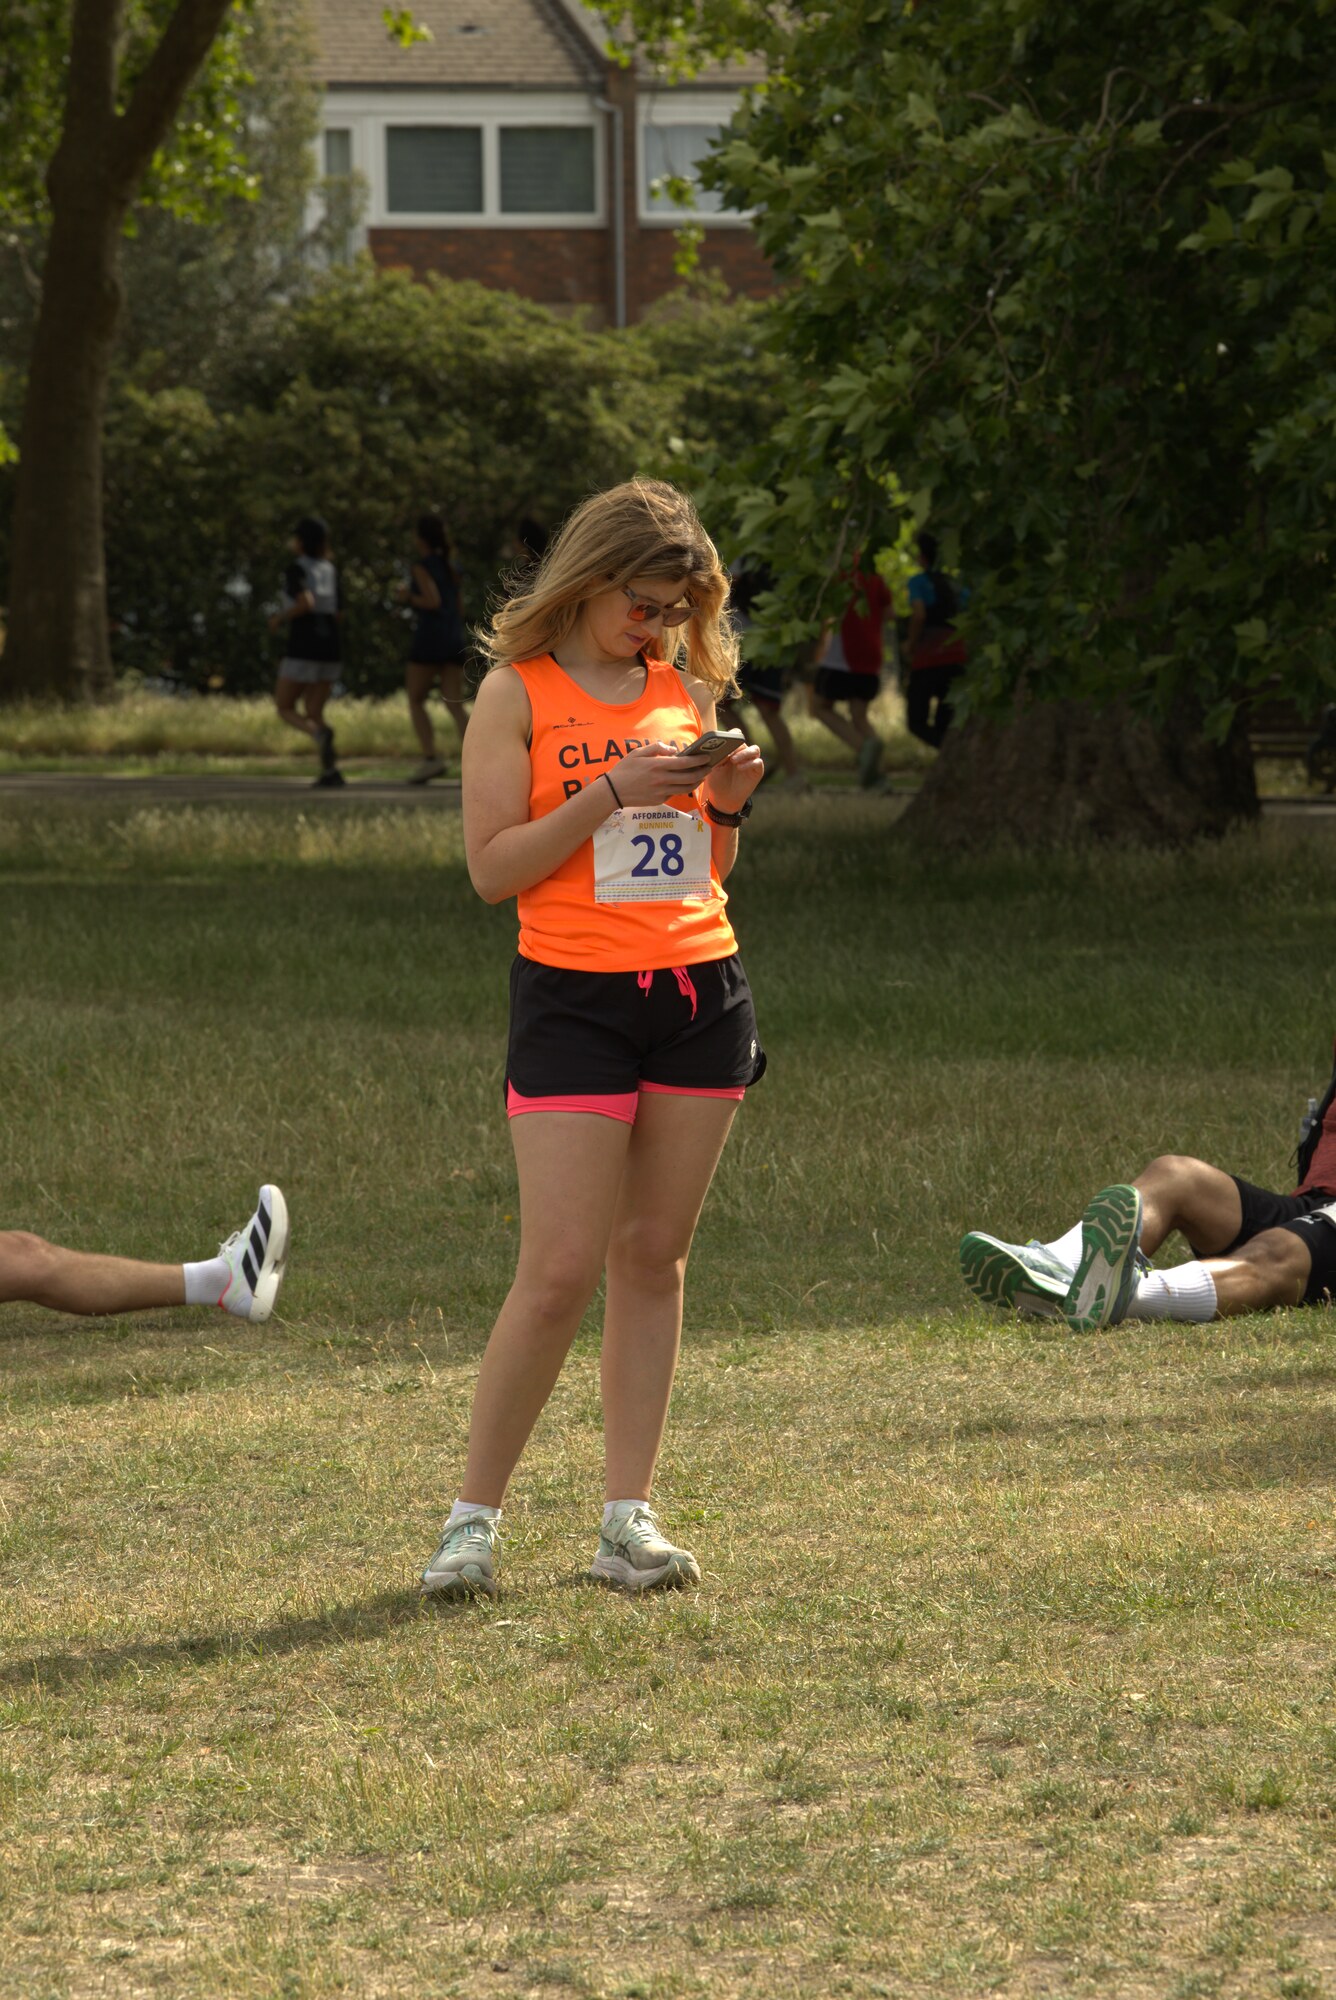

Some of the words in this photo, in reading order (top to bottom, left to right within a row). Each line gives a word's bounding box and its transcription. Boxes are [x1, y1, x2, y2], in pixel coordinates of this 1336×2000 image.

[632, 811, 679, 820] AFFORDABLE
[638, 821, 674, 830] RUNNING
[630, 833, 684, 877] 28
